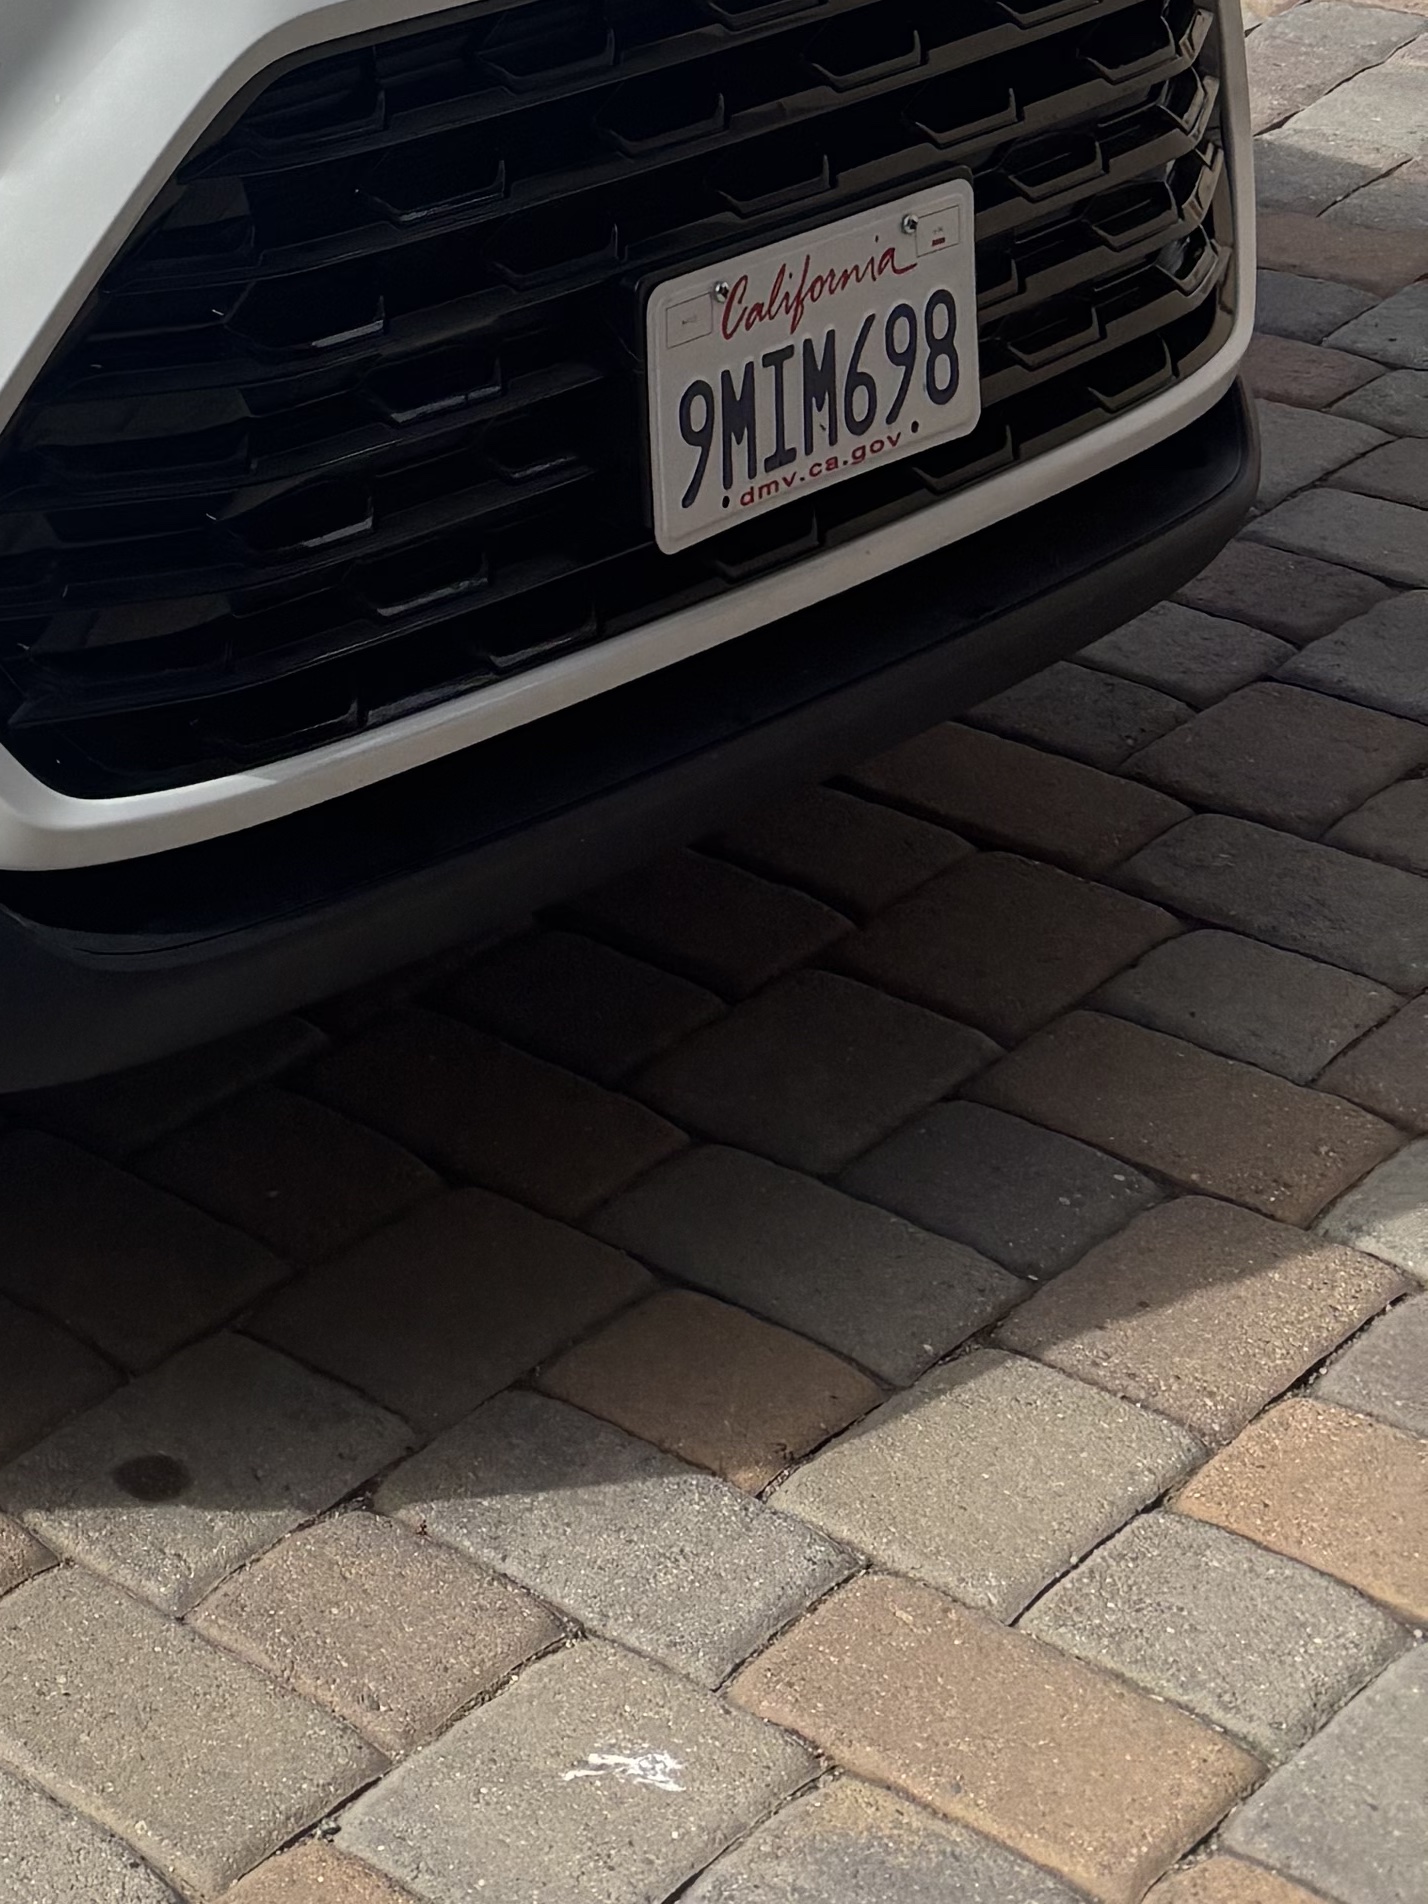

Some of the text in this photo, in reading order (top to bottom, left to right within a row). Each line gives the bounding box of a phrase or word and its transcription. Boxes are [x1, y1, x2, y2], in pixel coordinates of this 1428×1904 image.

[721, 235, 918, 341] California
[678, 288, 960, 510] 9MIM698
[739, 431, 902, 507] dmv.ca.gov
